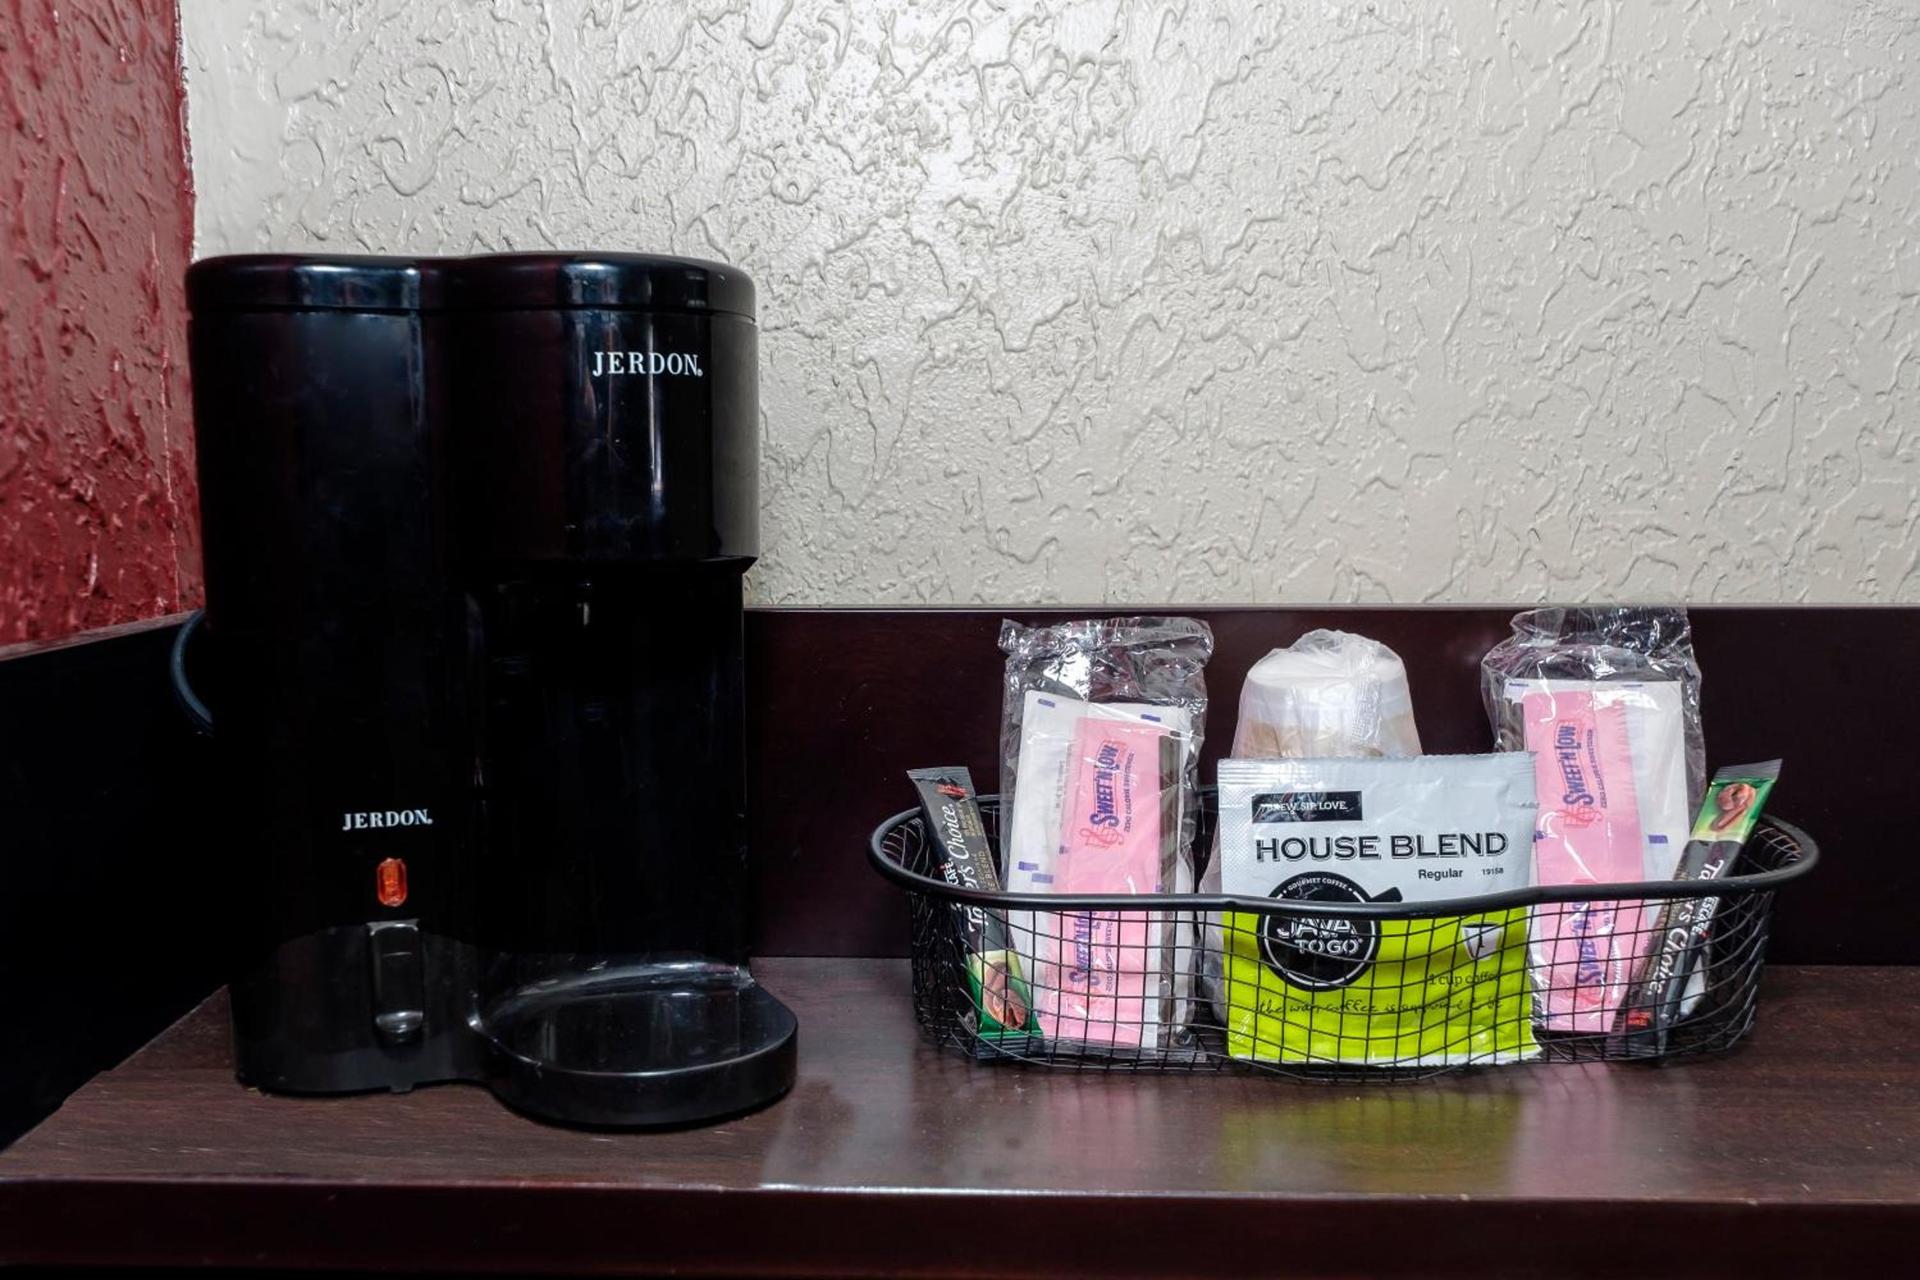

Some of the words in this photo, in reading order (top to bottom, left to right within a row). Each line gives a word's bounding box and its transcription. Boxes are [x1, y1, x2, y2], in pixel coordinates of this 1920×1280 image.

[1256, 836, 1382, 862] HOUSE
[1390, 832, 1508, 859] BLEND
[1418, 868, 1464, 881] Regular
[1321, 877, 1348, 889] COFFEE
